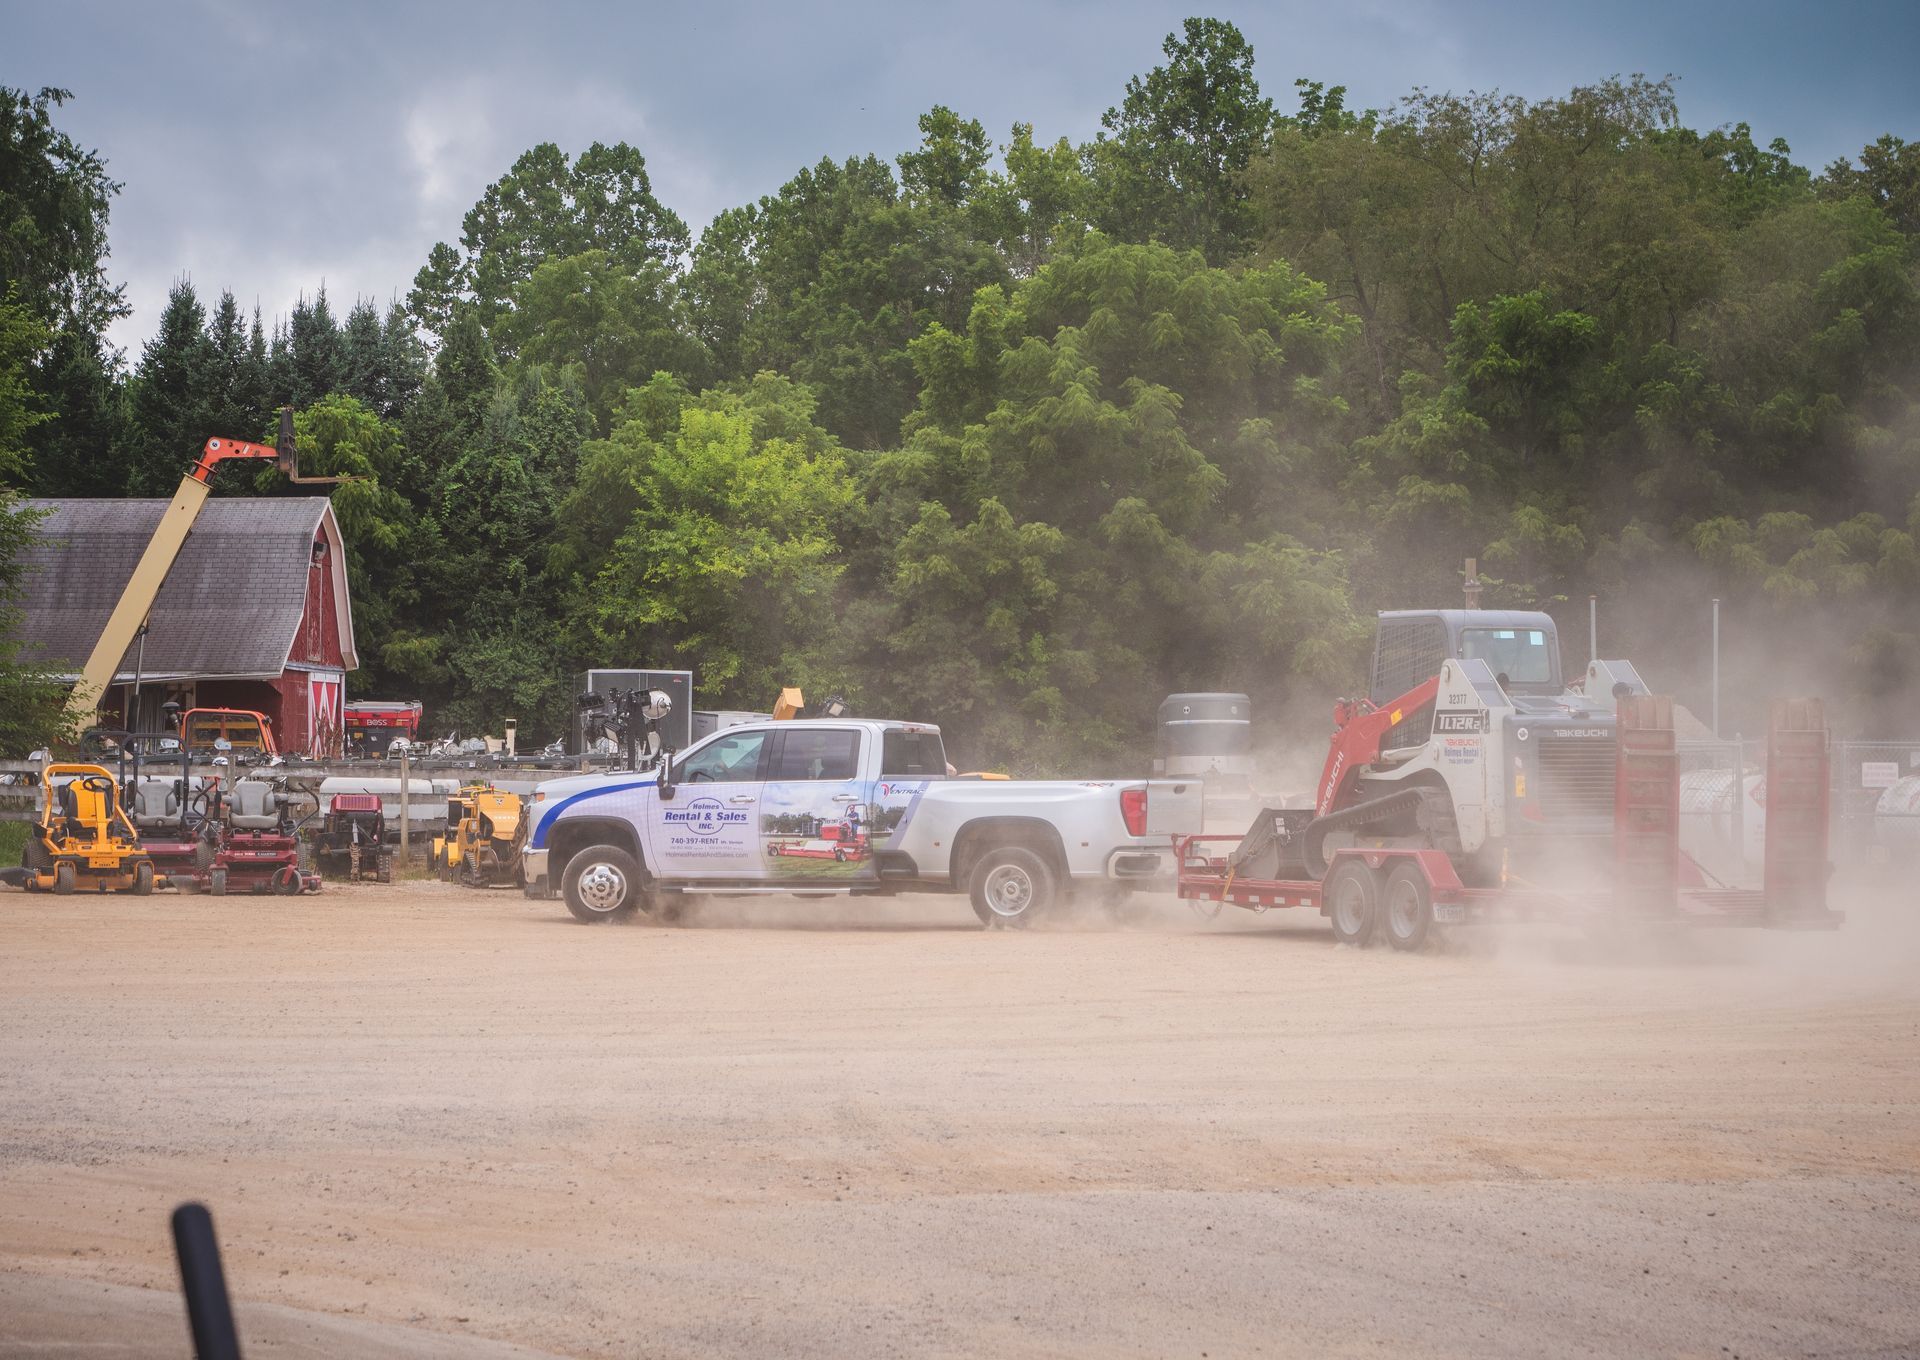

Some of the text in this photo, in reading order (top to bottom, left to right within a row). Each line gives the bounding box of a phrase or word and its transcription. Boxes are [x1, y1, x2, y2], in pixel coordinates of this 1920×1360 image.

[1449, 694, 1467, 705] 32377
[665, 812, 747, 821] Rental & Sales
